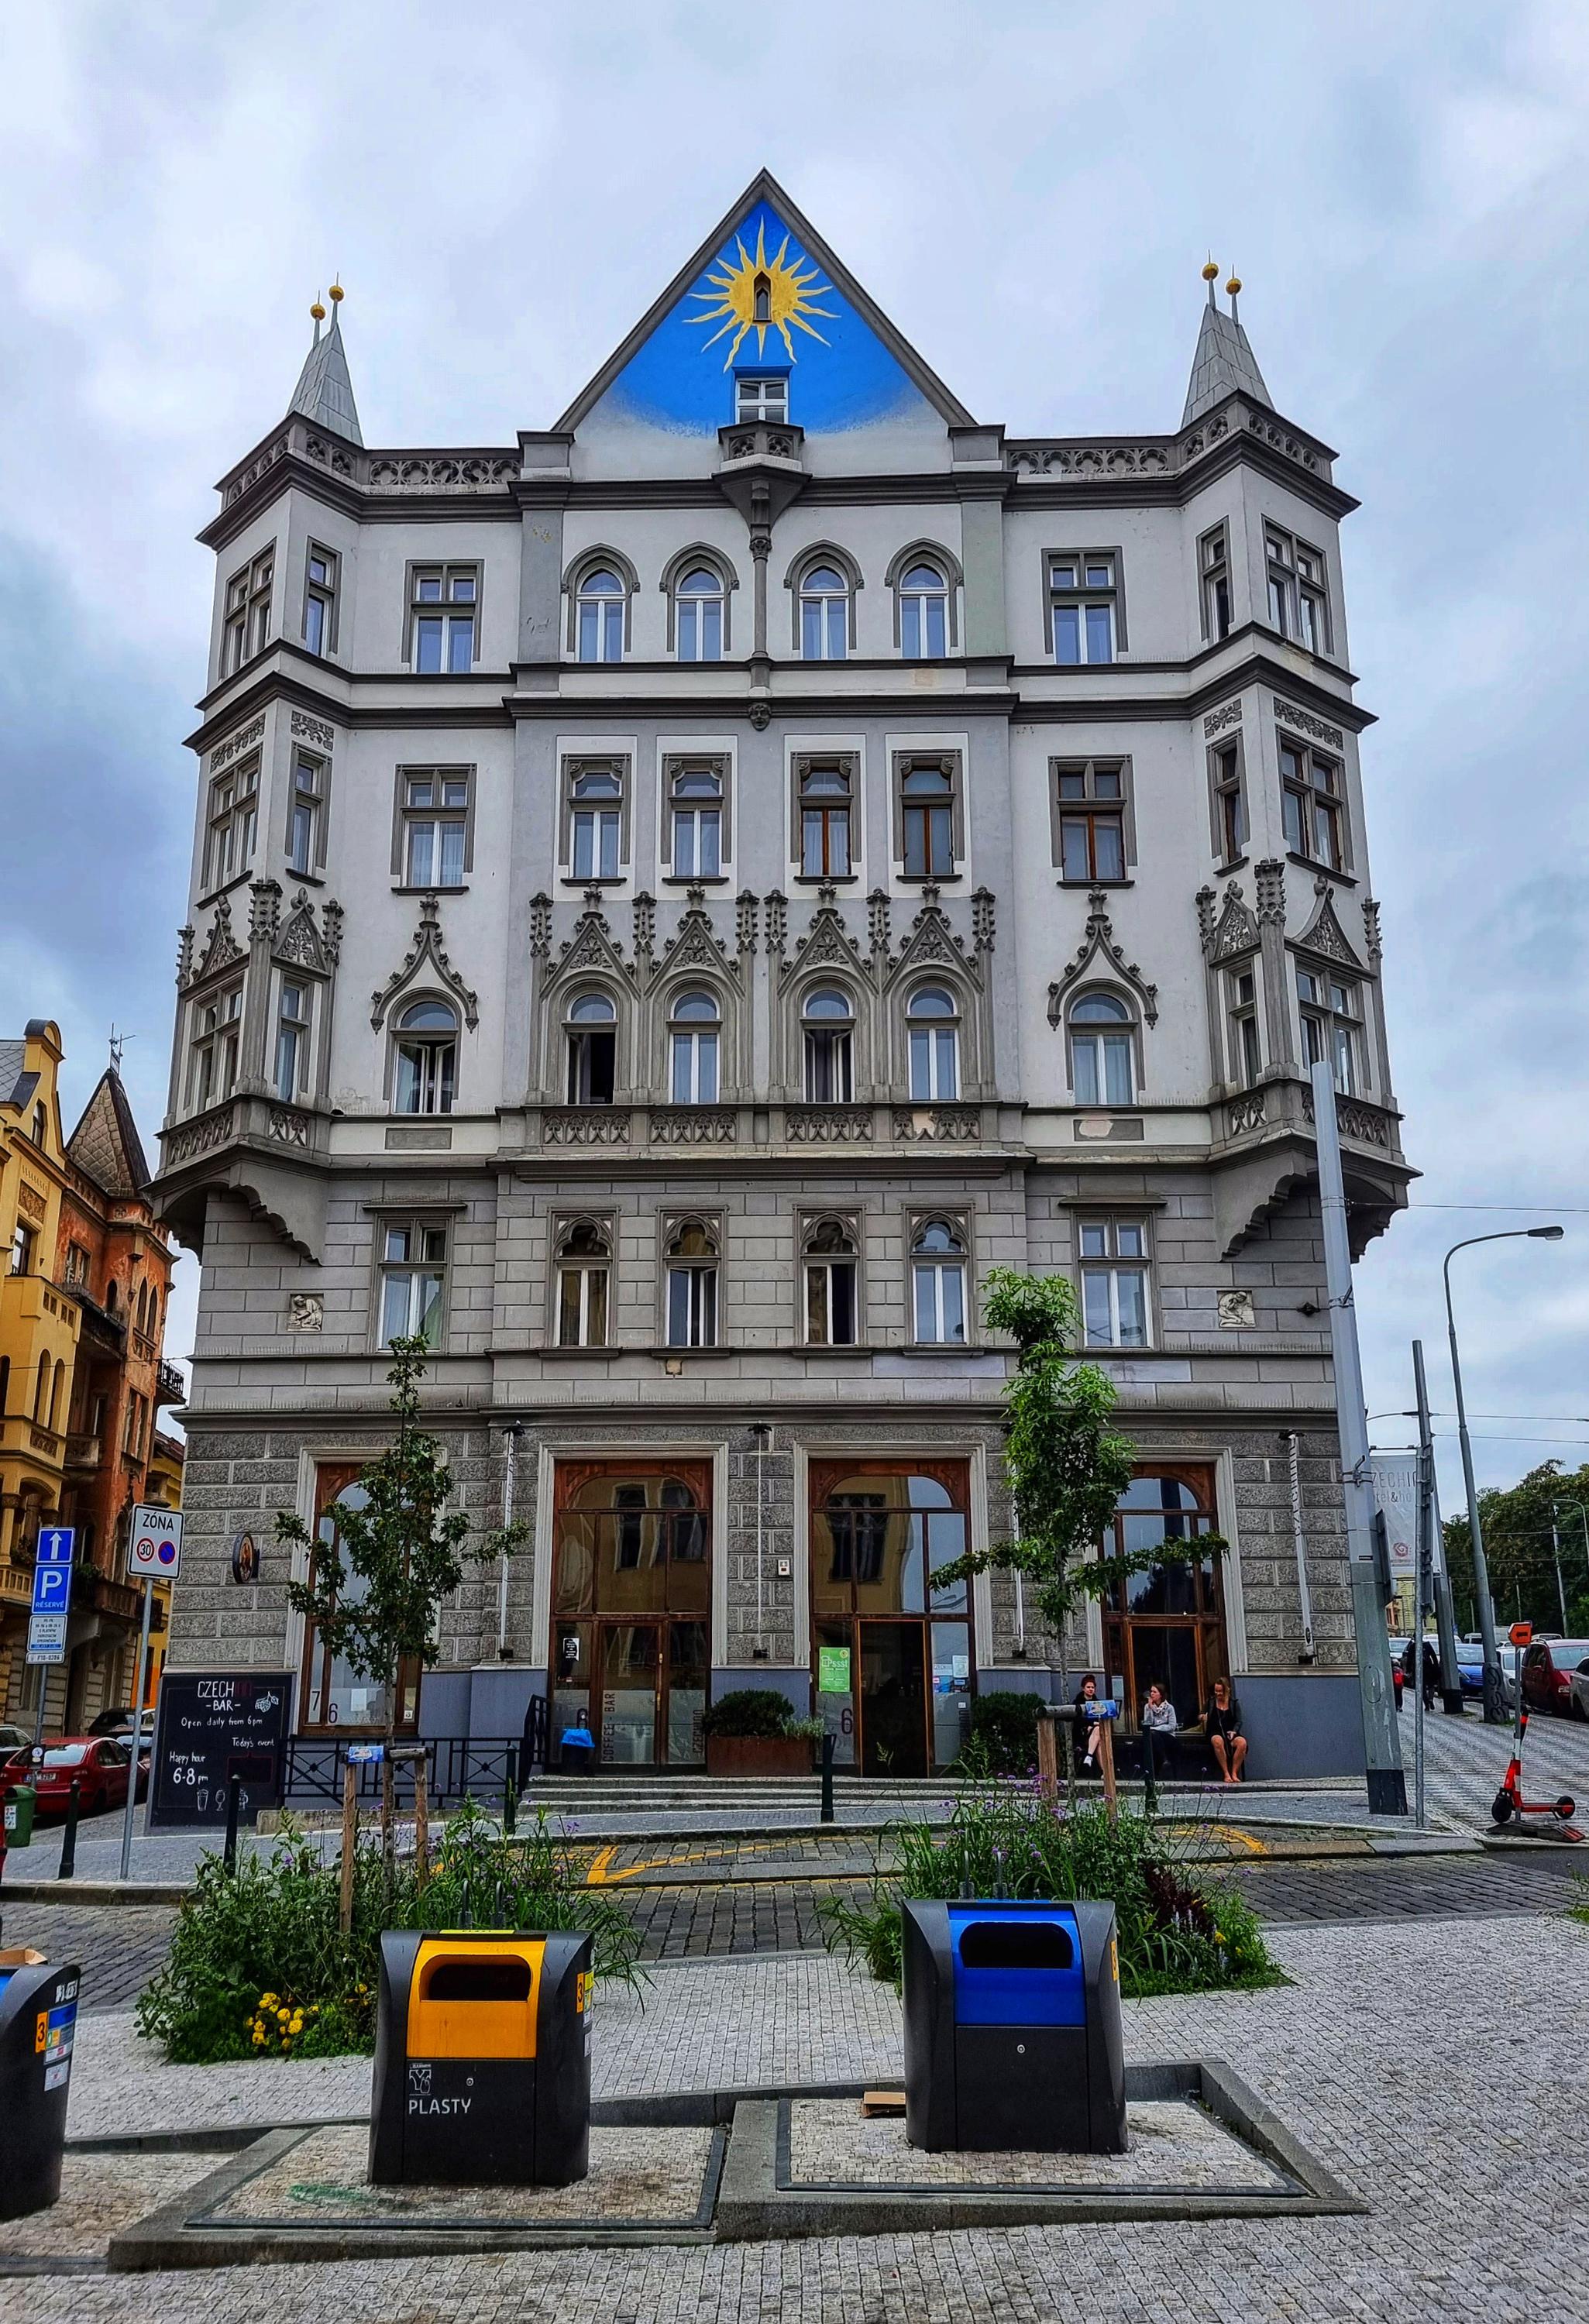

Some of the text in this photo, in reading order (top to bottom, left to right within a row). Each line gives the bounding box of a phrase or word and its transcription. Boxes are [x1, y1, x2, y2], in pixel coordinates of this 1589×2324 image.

[142, 1512, 174, 1532] ZÓNA
[139, 1543, 151, 1556] 30
[40, 1571, 63, 1599] P
[312, 1690, 320, 1711] 7
[604, 1693, 615, 1713] BAR
[181, 1717, 201, 1729] Open
[207, 1717, 225, 1729] daily
[229, 1717, 244, 1726] from
[328, 1703, 339, 1724] 6
[841, 1708, 852, 1734] 6
[232, 1738, 275, 1748] Today's event
[603, 1724, 615, 1762] COFFEE
[169, 1751, 206, 1765] Happy hour
[173, 1767, 208, 1785] 6-8 pm
[37, 2022, 45, 2043] 3
[409, 2099, 472, 2114] PLASTY
